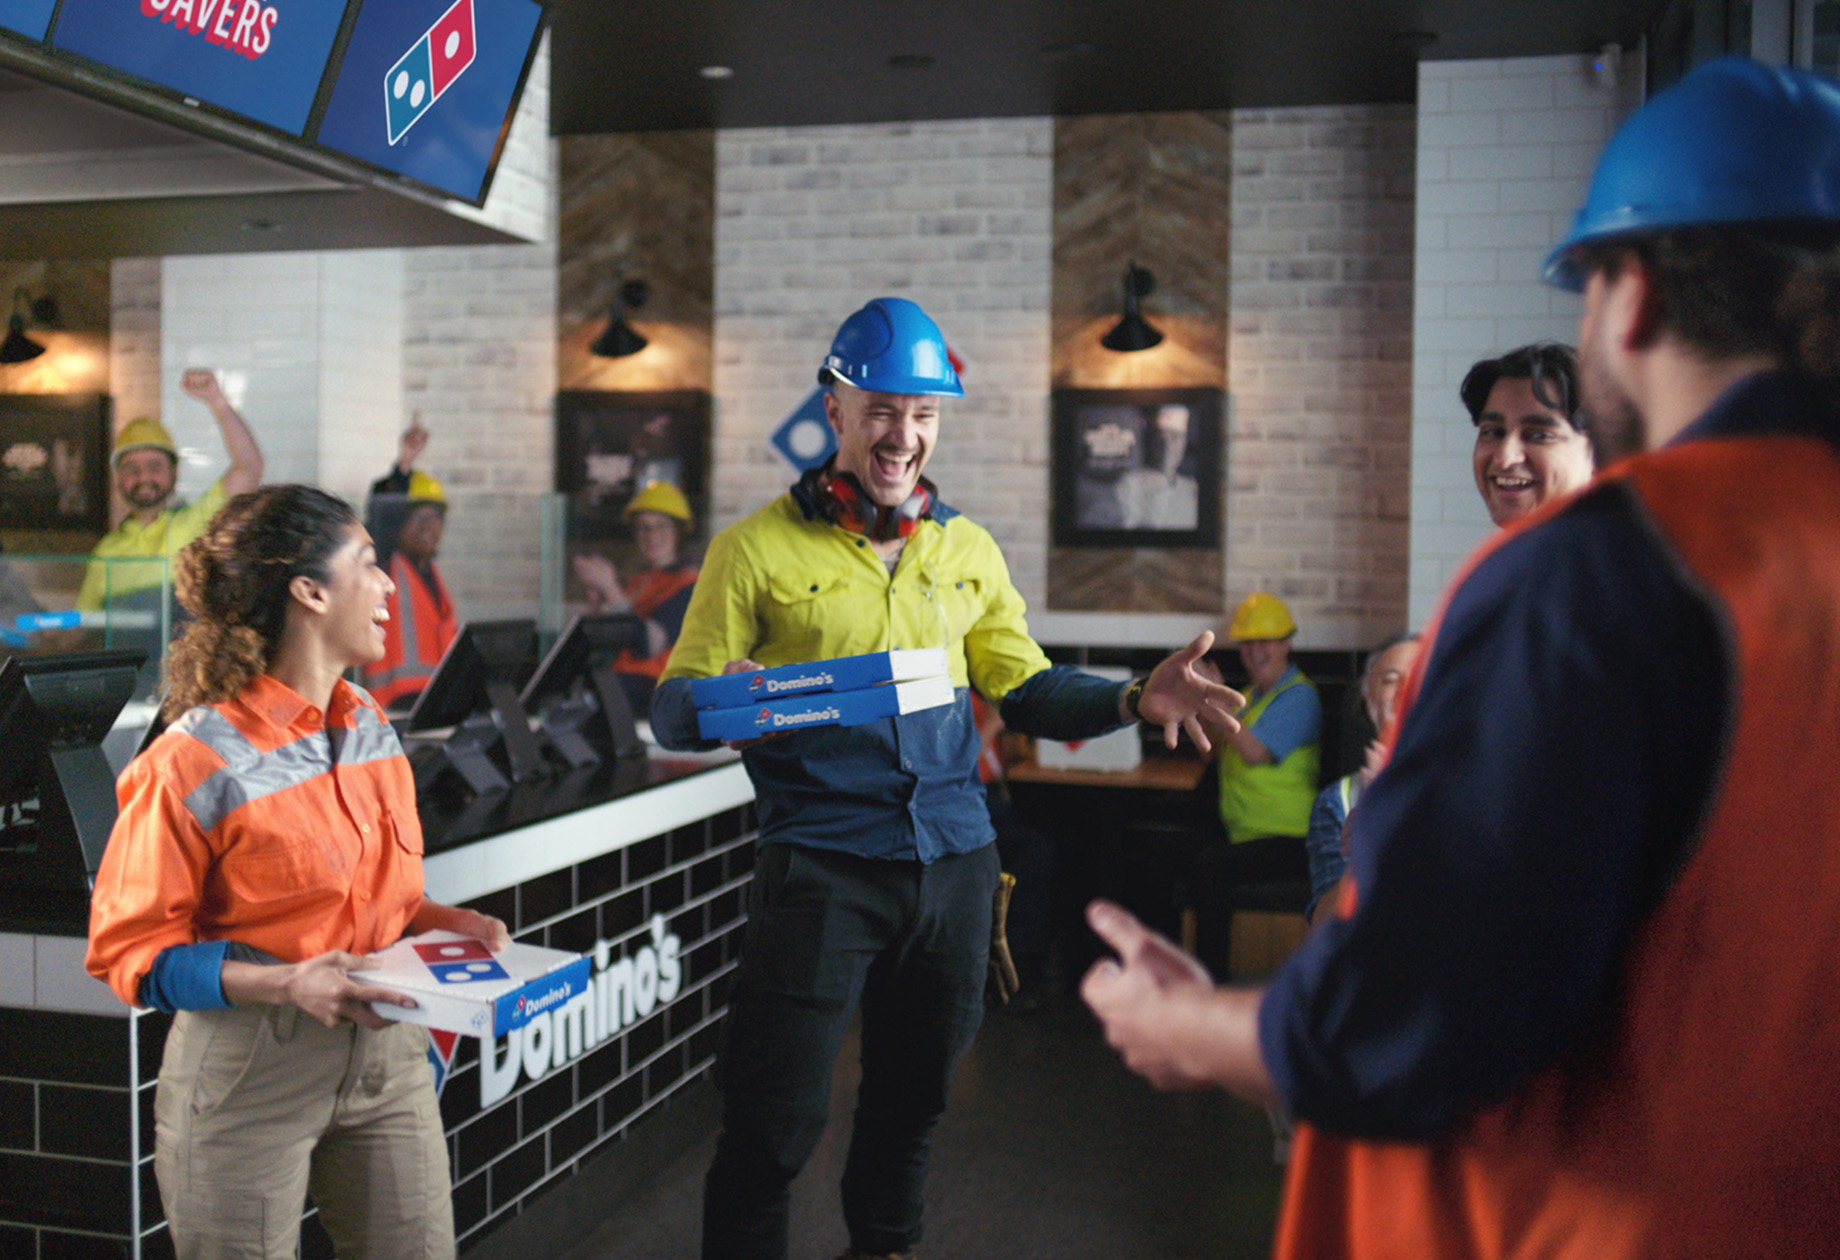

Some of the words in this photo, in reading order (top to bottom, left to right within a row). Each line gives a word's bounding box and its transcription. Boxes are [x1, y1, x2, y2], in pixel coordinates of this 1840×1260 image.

[144, 0, 278, 56] AVERS
[767, 671, 834, 692] Domino's
[773, 706, 840, 726] Domino's
[525, 981, 572, 1017] Domino's
